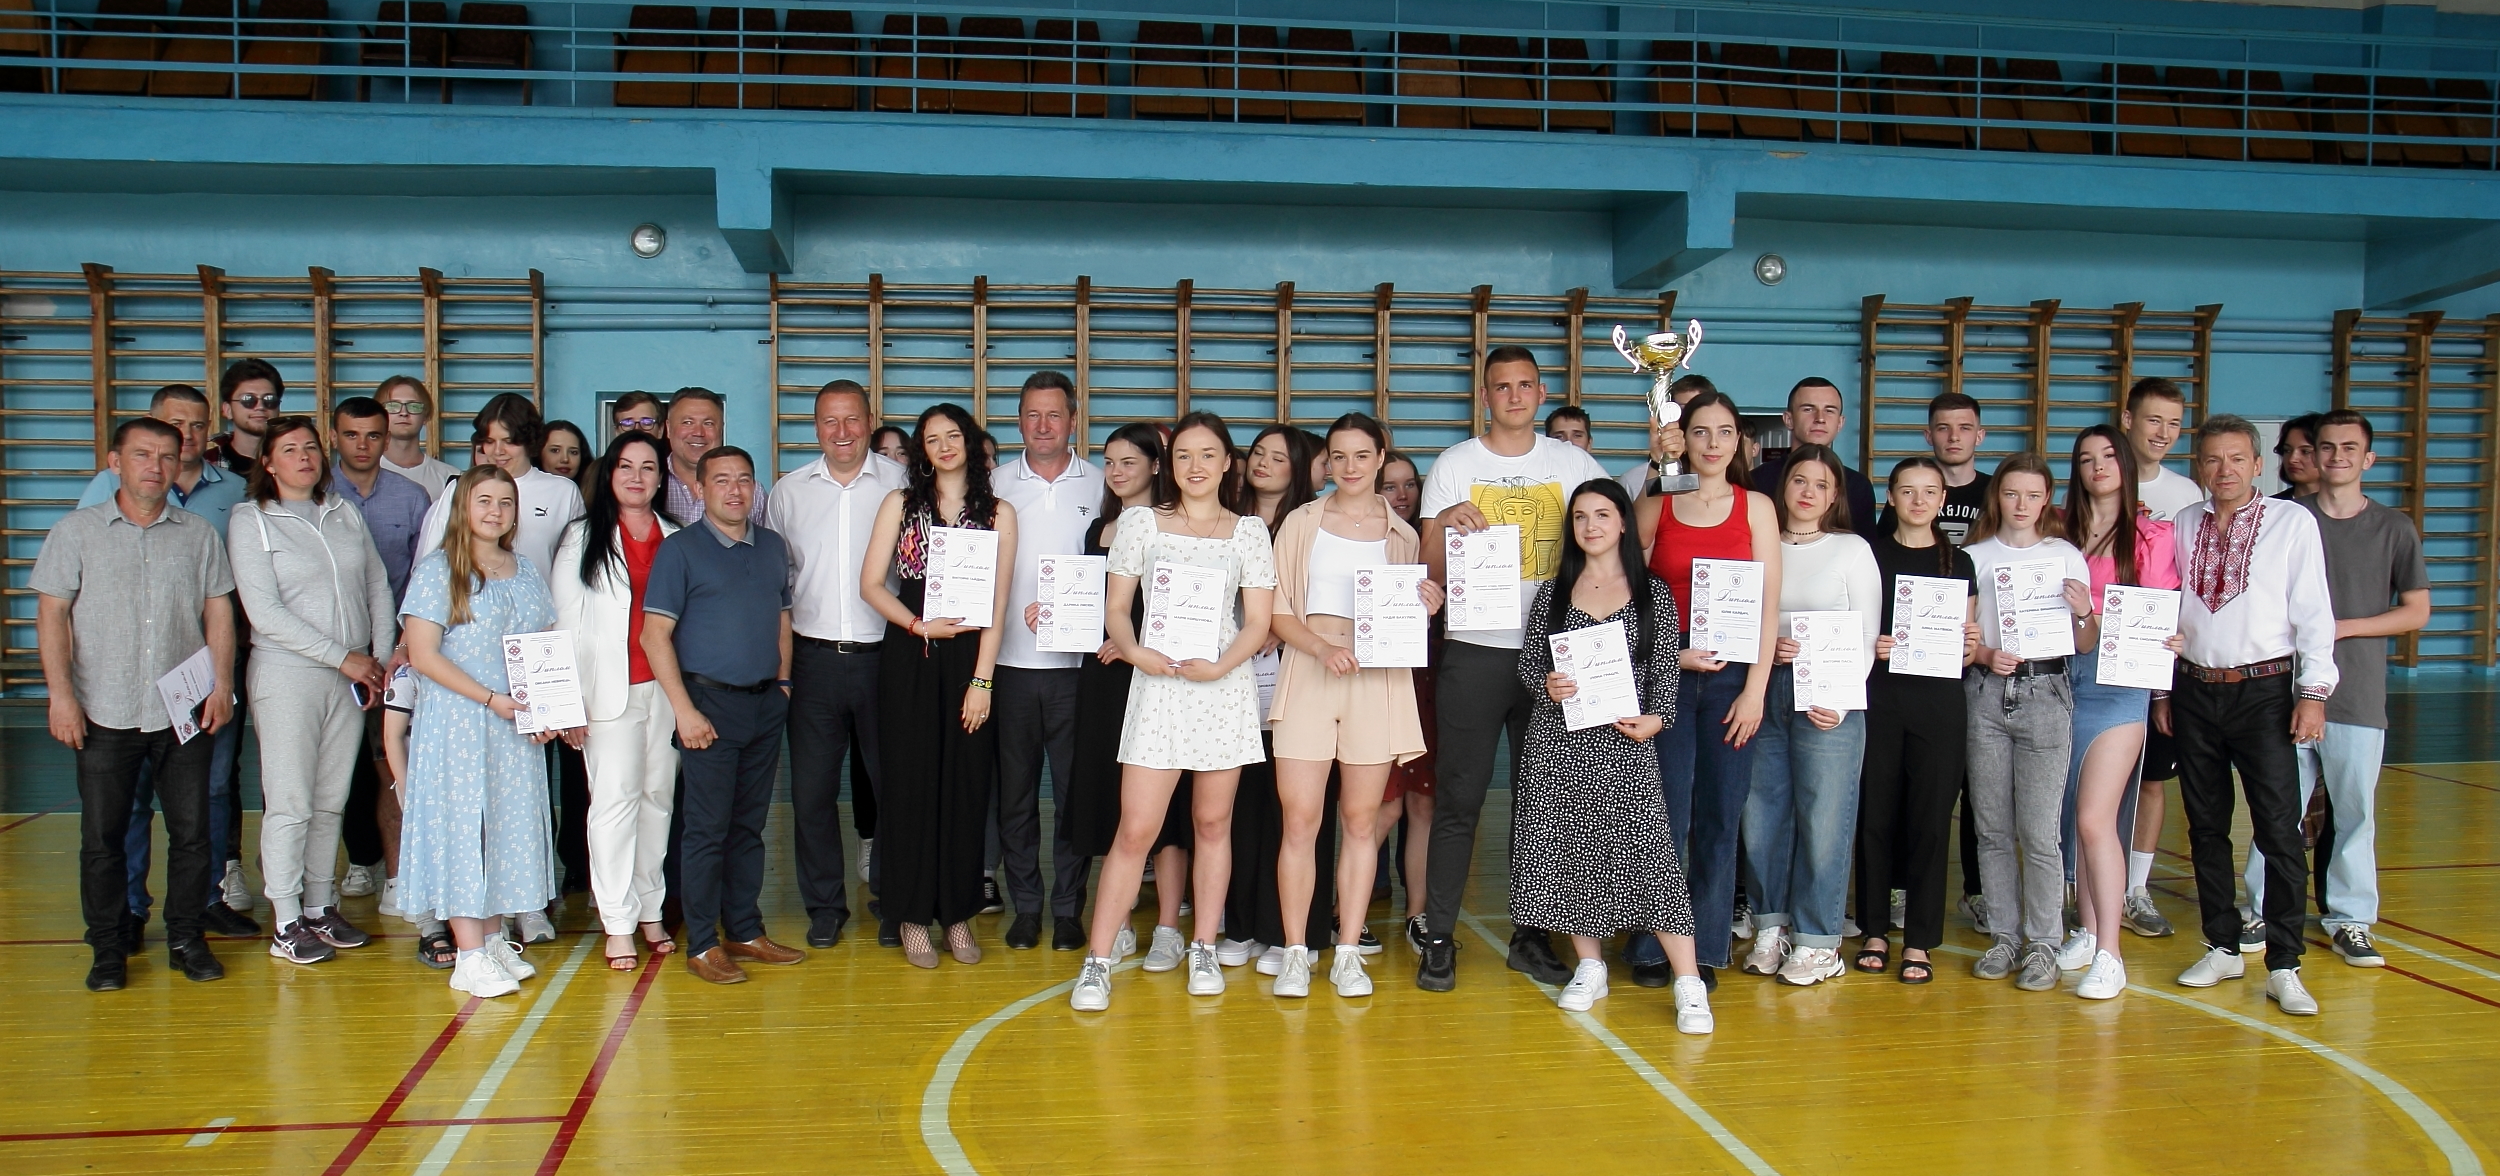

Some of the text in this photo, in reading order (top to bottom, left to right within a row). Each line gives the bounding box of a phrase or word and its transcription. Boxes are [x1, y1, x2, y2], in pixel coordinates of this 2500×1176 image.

[949, 556, 990, 570] Диплом
[1470, 556, 1513, 570] Диплом
[1059, 582, 1099, 596] Диплом
[1173, 595, 1216, 611] Диплом
[1378, 593, 1421, 607] Диплом
[1714, 589, 1756, 604] Диплом
[1916, 605, 1960, 620] Диплом
[2125, 616, 2170, 631] Диплом
[530, 660, 571, 674] Диплом
[1580, 654, 1623, 670] Диплом
